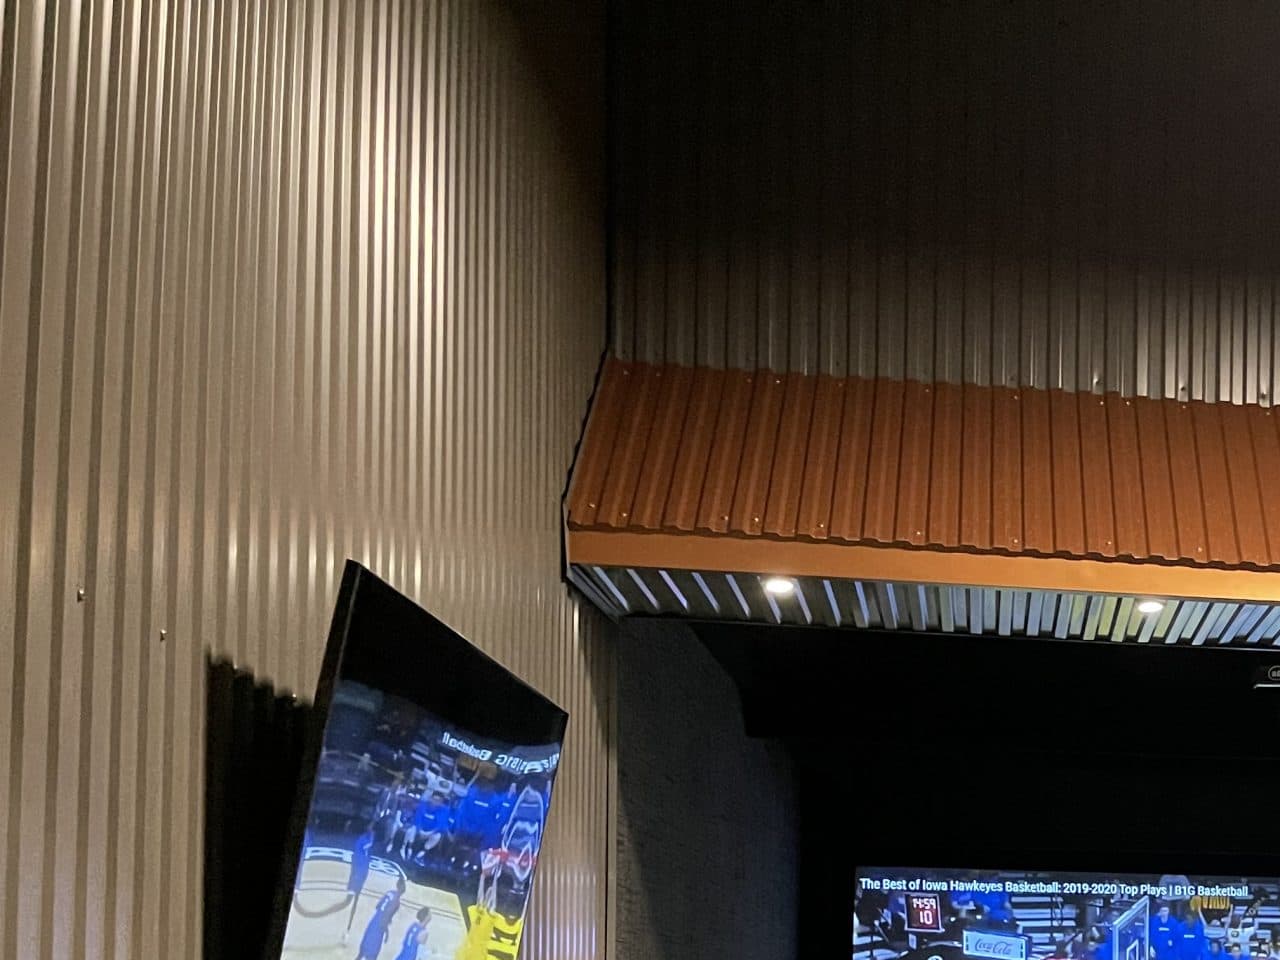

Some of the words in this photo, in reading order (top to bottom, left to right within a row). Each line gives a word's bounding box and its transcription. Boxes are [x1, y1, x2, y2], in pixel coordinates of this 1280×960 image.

[859, 878, 880, 890] The
[882, 878, 907, 890] Best
[908, 878, 921, 891] of
[922, 879, 948, 891] Iowa
[949, 879, 1003, 894] Hawkeyes
[1005, 880, 1061, 893] Basketball:
[1063, 883, 1117, 895] 2019-2020
[1119, 883, 1137, 897] Top
[1140, 883, 1167, 898] Plays
[1174, 885, 1195, 897] B1G
[1199, 884, 1249, 897] Basketball
[919, 910, 933, 925] 10
